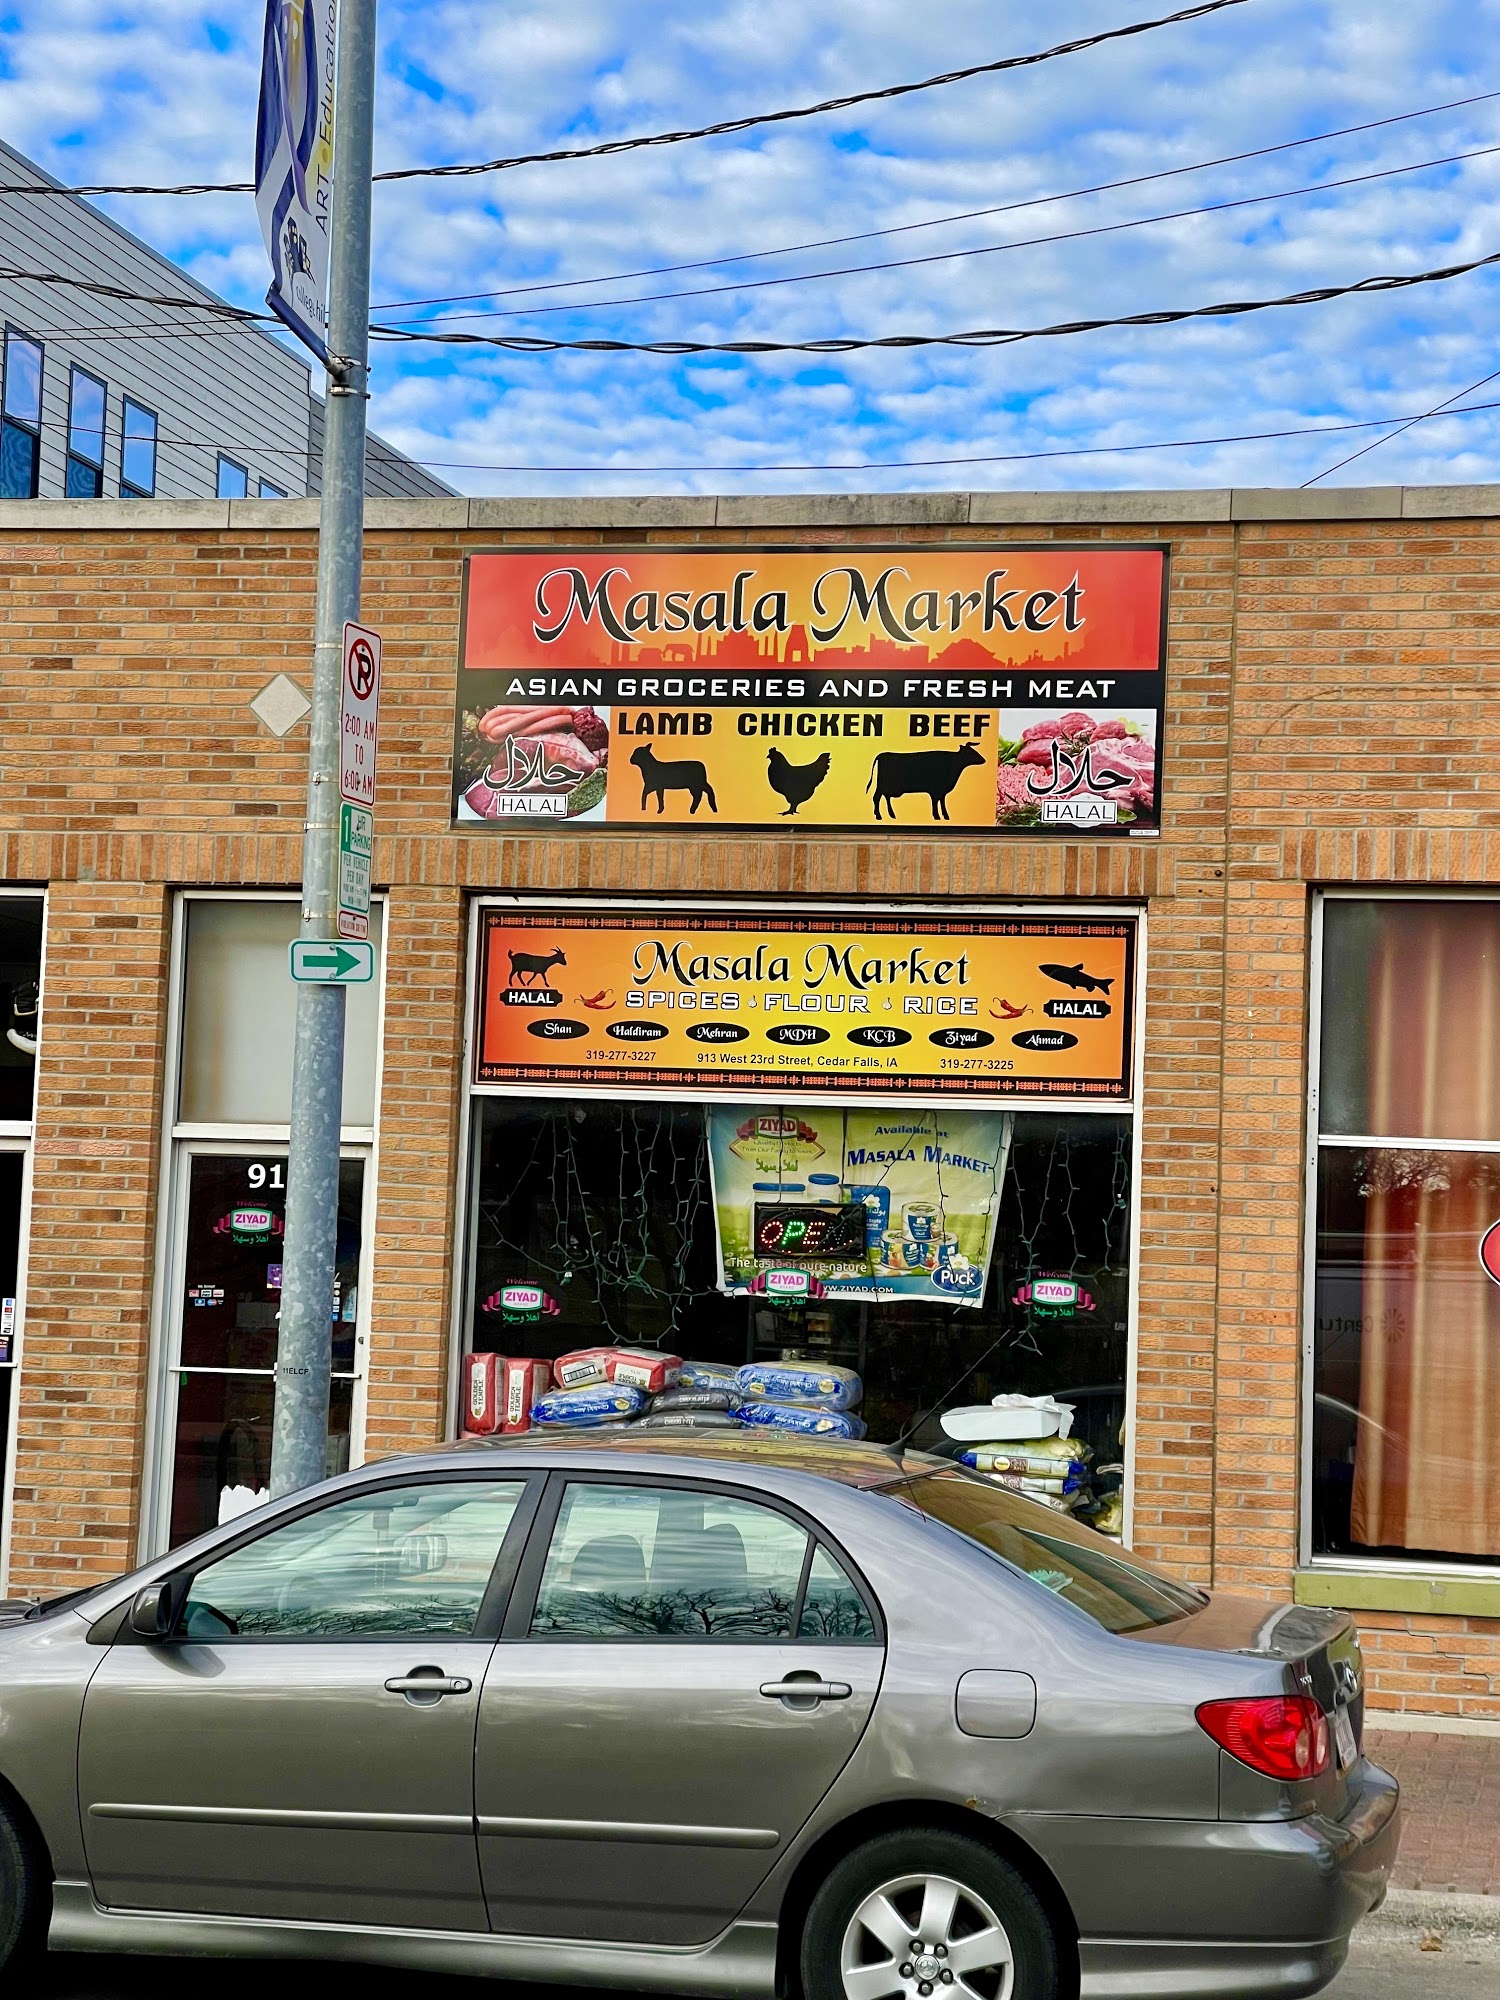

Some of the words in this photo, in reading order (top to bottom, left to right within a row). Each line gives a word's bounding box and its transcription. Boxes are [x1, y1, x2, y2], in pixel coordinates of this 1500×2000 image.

[315, 163, 330, 236] ART
[533, 567, 796, 644] Masala
[809, 566, 1086, 645] Market
[505, 677, 603, 698] ASIAN
[617, 678, 806, 699] GROCERIES
[819, 679, 889, 699] AND
[903, 679, 1013, 699] FRESH
[1029, 679, 1116, 699] MEAT
[345, 713, 360, 737] 2:00
[363, 720, 375, 742] AM
[618, 711, 713, 736] LAMB
[737, 712, 884, 737] CHICKEN
[909, 712, 991, 738] BEEF
[355, 744, 364, 765] TO
[482, 733, 584, 791] حلال
[1026, 738, 1135, 796] حلال
[344, 769, 361, 792] 6:00
[362, 775, 373, 795] AM
[501, 798, 564, 813] HALAL
[1046, 804, 1113, 819] HALAL
[344, 815, 350, 843] 1
[632, 939, 793, 987] Masala
[803, 943, 971, 991] Market
[508, 991, 555, 1004] HALAL
[625, 990, 740, 1010] SPICES
[764, 993, 871, 1013] FLOUR
[903, 996, 978, 1016] RICE
[1053, 1003, 1102, 1016] HALAL
[543, 1022, 572, 1036] Shan
[612, 1026, 662, 1037] Haldiram
[696, 1026, 738, 1039] Mehran
[779, 1028, 817, 1042] MDH
[863, 1028, 896, 1044] KCB
[945, 1031, 978, 1046] Ziyad
[1025, 1034, 1064, 1046] Ahmad
[586, 1049, 657, 1062] 319-277-3227
[697, 1053, 717, 1063] 913
[719, 1053, 747, 1064] West
[750, 1054, 775, 1065] 23rd
[778, 1054, 814, 1067] Street,
[817, 1055, 850, 1067] Cedar
[853, 1056, 883, 1069] Falls,
[886, 1057, 898, 1068] IA
[940, 1058, 1014, 1070] 319-277-3225
[760, 1118, 796, 1132] ZIYAD
[874, 1125, 932, 1136] Available
[847, 1148, 916, 1167] MASALA
[923, 1145, 990, 1174] MARKET
[247, 1163, 285, 1189] 91
[234, 1214, 268, 1224] ZIYAD
[760, 1220, 847, 1245] OPEN
[730, 1257, 751, 1268] The
[753, 1258, 783, 1269] taste
[829, 1262, 867, 1273] nature
[770, 1273, 805, 1286] ZIYAD
[941, 1269, 976, 1286] Puck
[505, 1291, 539, 1303] ZIYAD
[1036, 1285, 1073, 1297] ZIYAD
